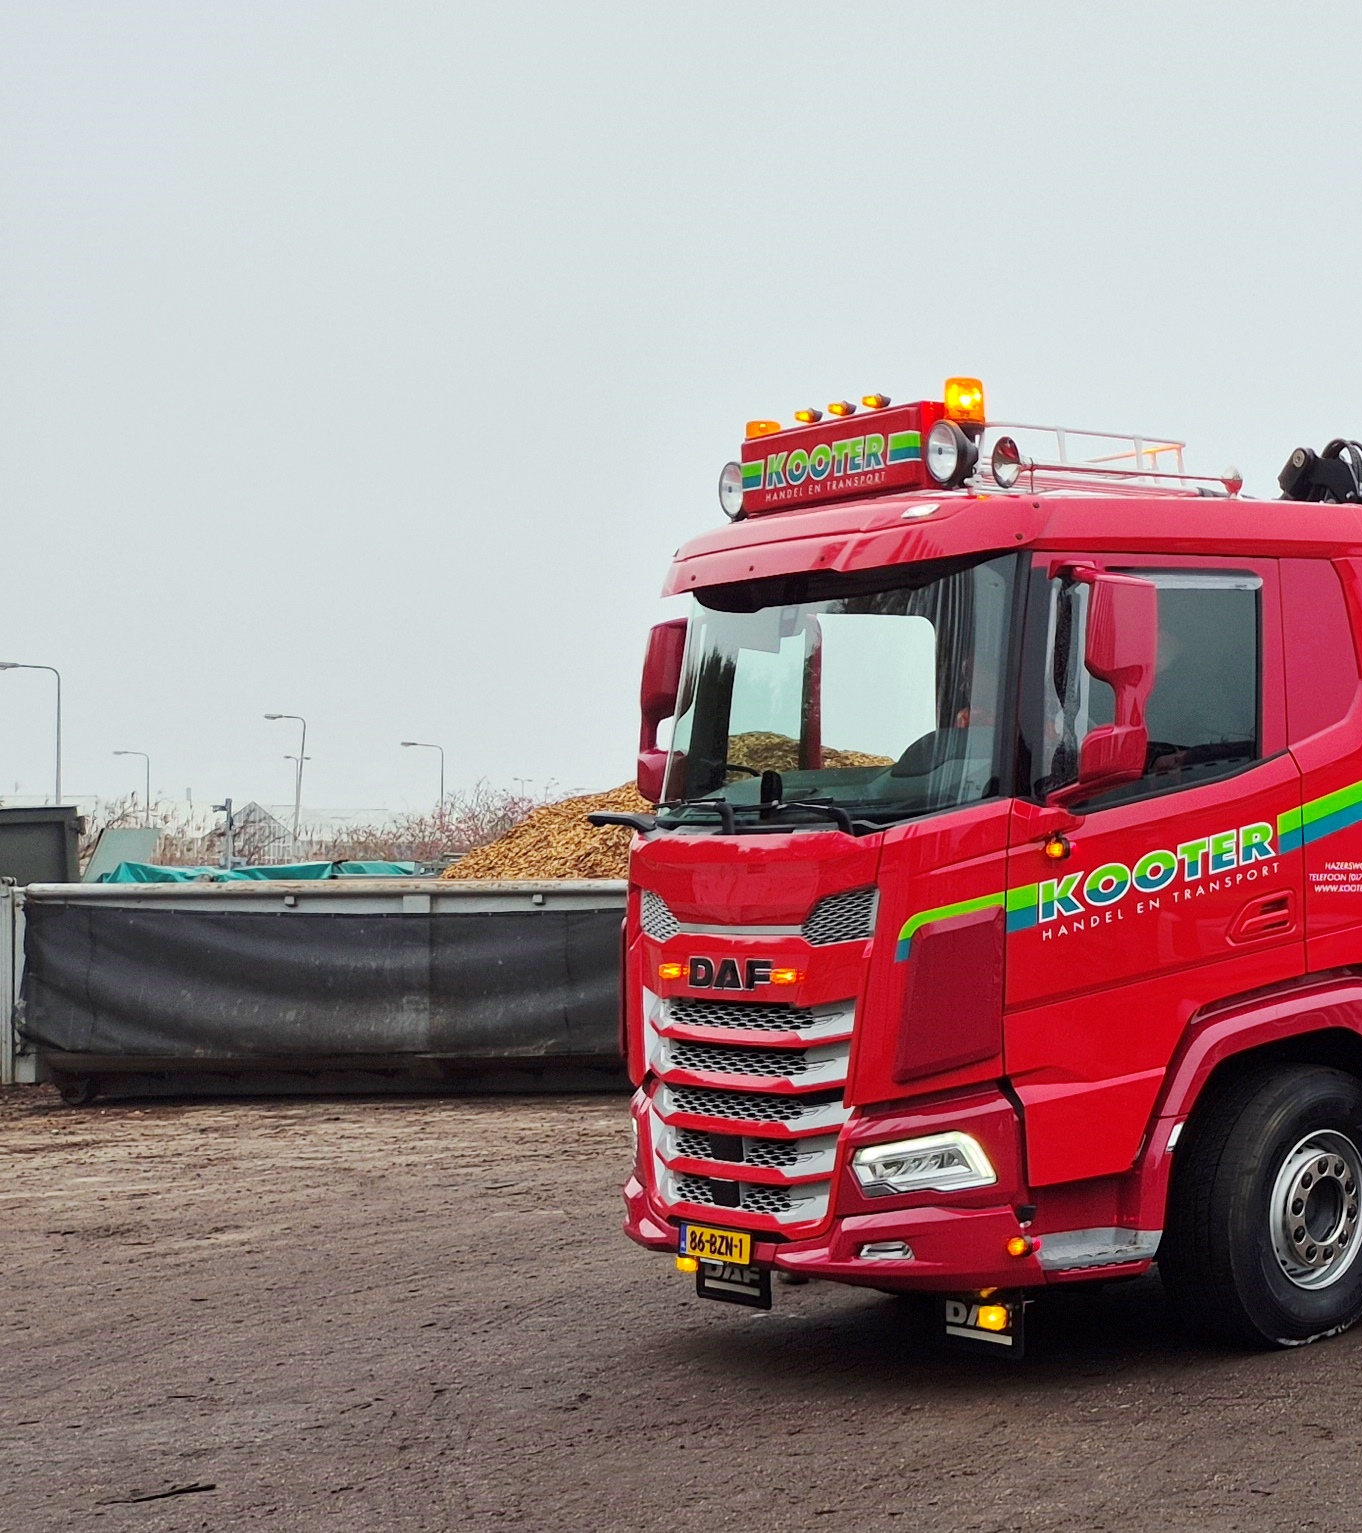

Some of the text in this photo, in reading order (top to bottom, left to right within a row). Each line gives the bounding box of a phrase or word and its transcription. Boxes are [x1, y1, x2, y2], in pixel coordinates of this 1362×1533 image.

[764, 433, 885, 490] KOOTER
[765, 472, 886, 502] HANDEL EN TRANSPORT
[1038, 821, 1276, 924] KOOTER
[1308, 873, 1347, 881] TELEFOON
[1042, 862, 1280, 941] HANDEL EN TRANSPORT
[688, 955, 774, 991] DAF
[689, 1230, 743, 1259] 86-BZN-1
